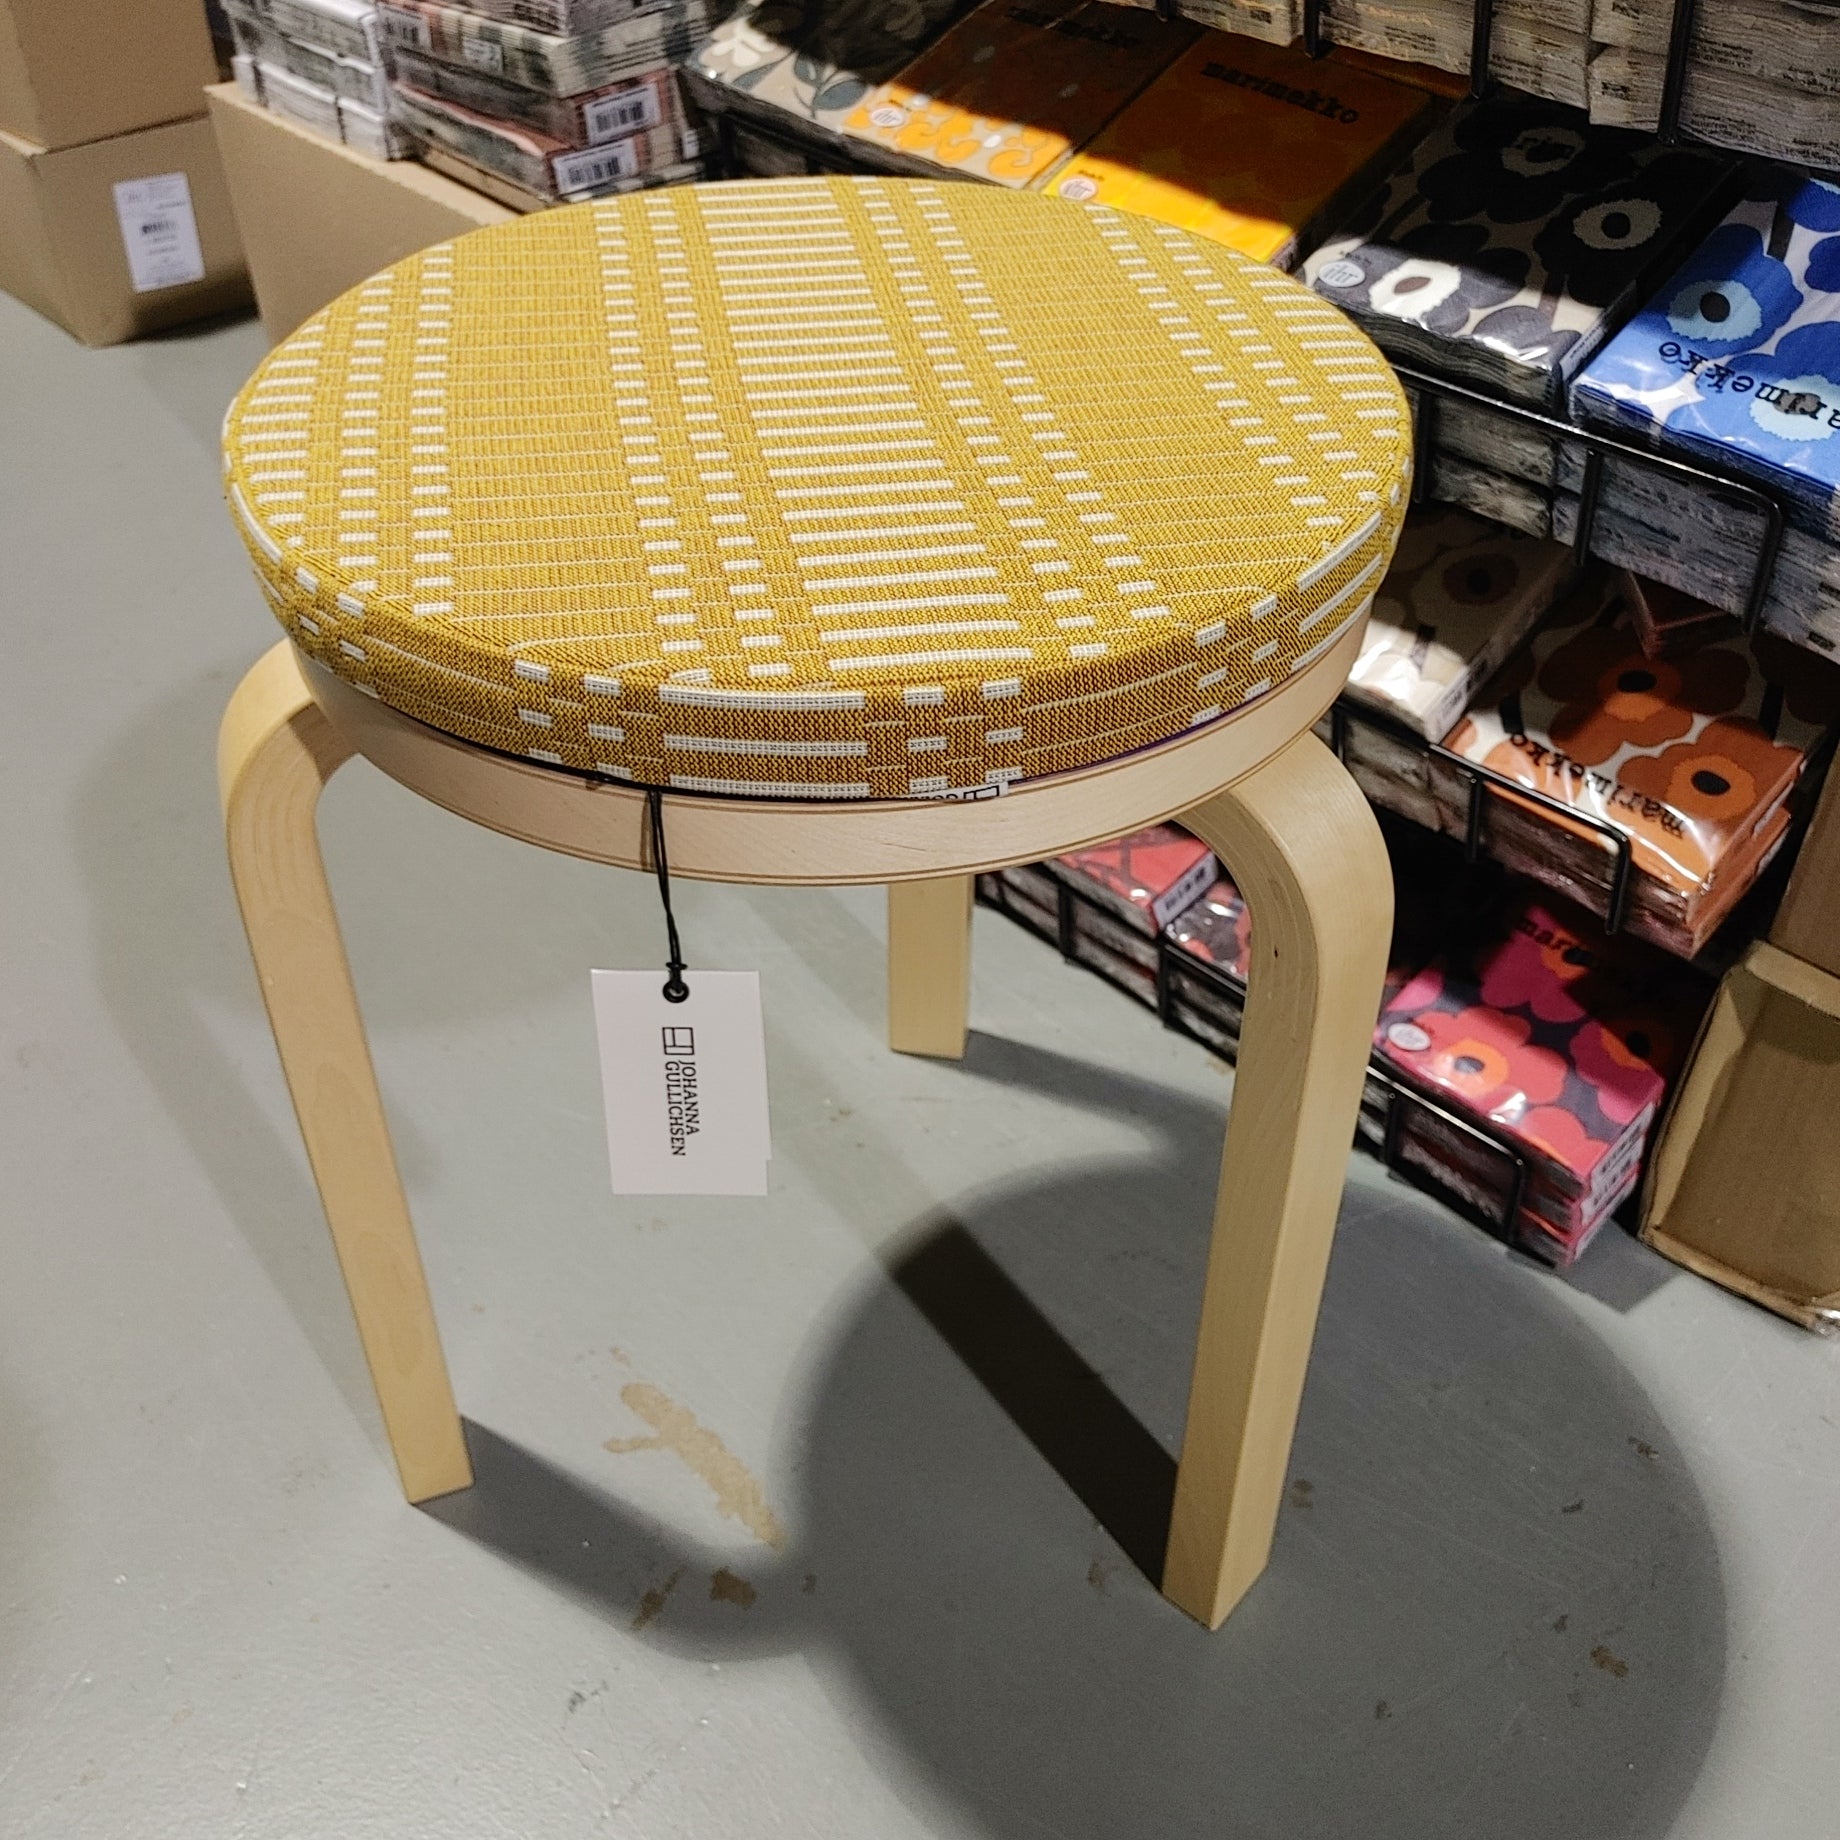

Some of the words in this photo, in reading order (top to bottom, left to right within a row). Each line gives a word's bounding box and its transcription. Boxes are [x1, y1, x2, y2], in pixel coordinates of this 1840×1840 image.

[1658, 341, 1840, 430] arimekko
[664, 1060, 686, 1157] GULLICHSEN
[678, 1059, 700, 1136] JOHANNA
